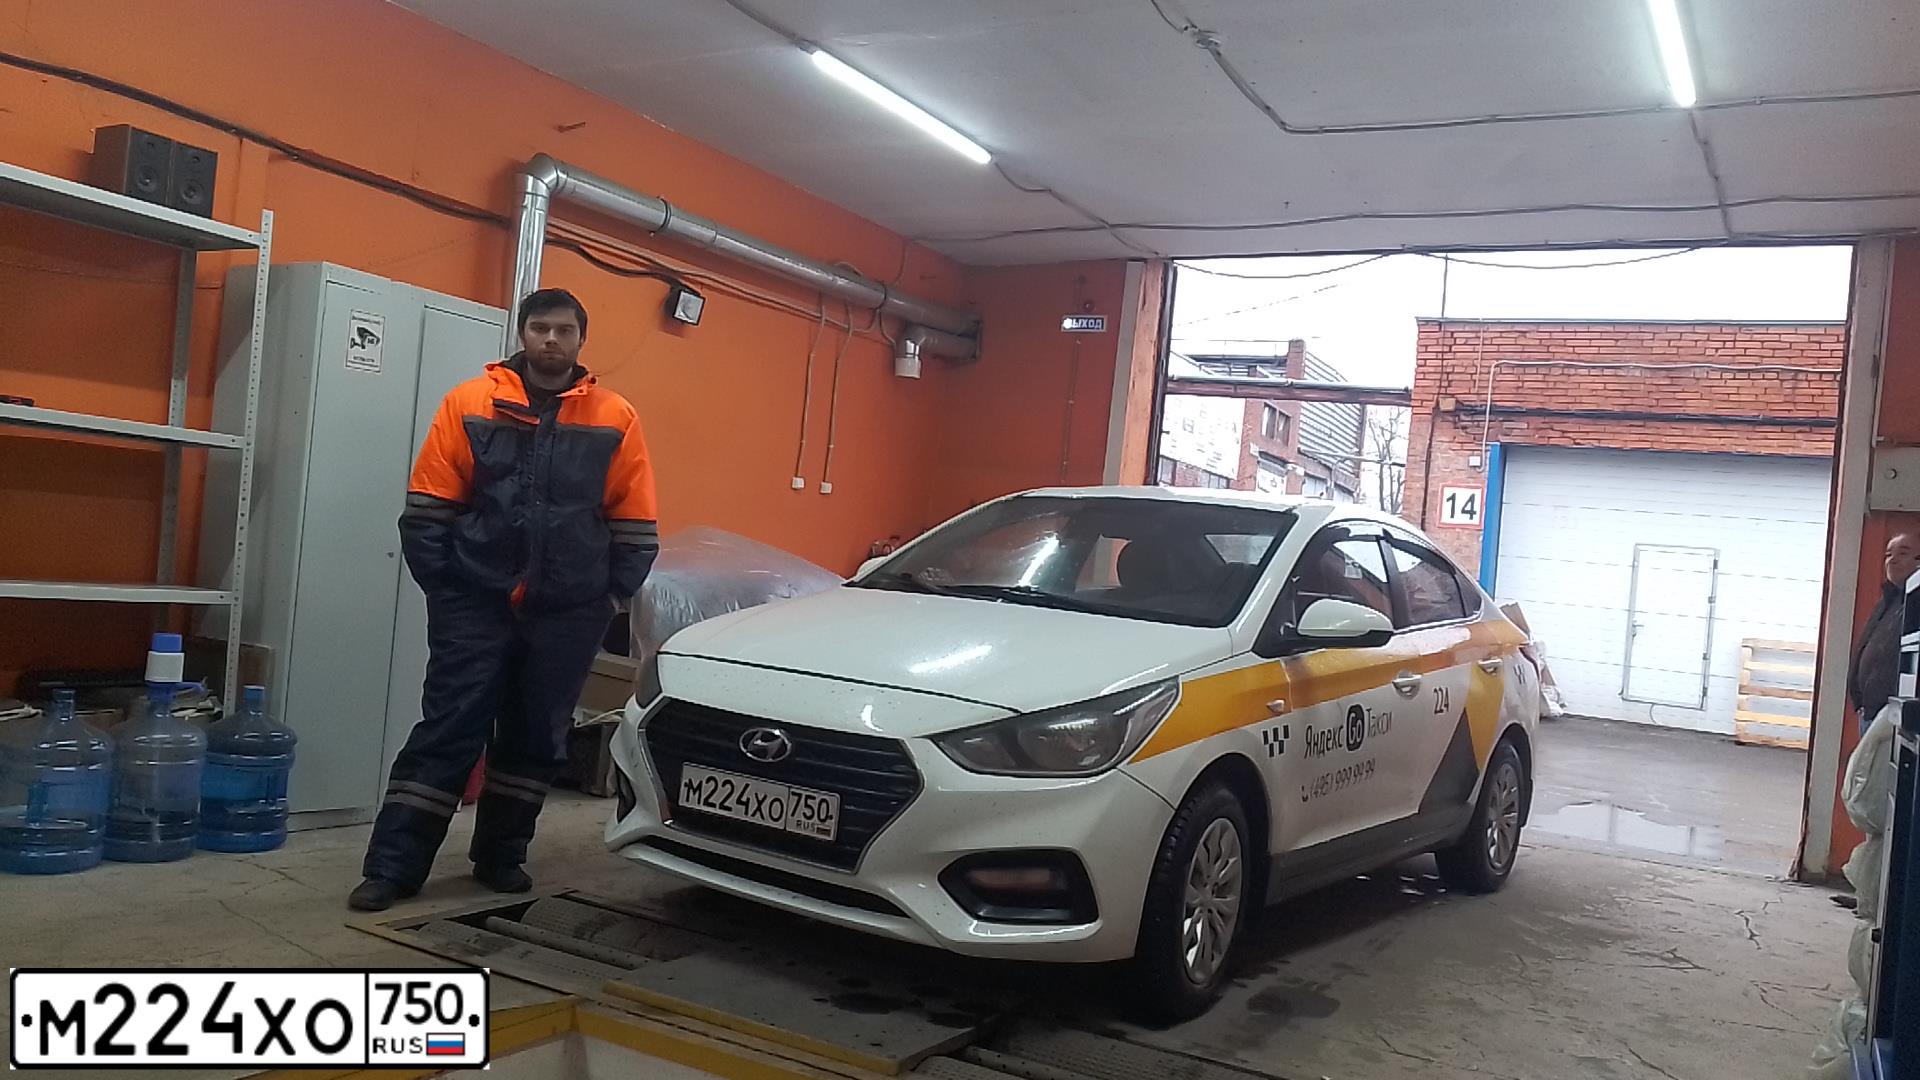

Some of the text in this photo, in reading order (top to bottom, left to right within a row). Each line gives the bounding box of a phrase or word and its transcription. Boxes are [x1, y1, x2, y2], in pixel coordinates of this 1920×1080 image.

[1063, 317, 1102, 329] ЫХОД
[1446, 492, 1477, 521] 14
[1433, 686, 1449, 714] 224
[1304, 707, 1392, 759] Яндекс Go Такси
[790, 791, 830, 823] 750
[796, 819, 816, 831] RUS
